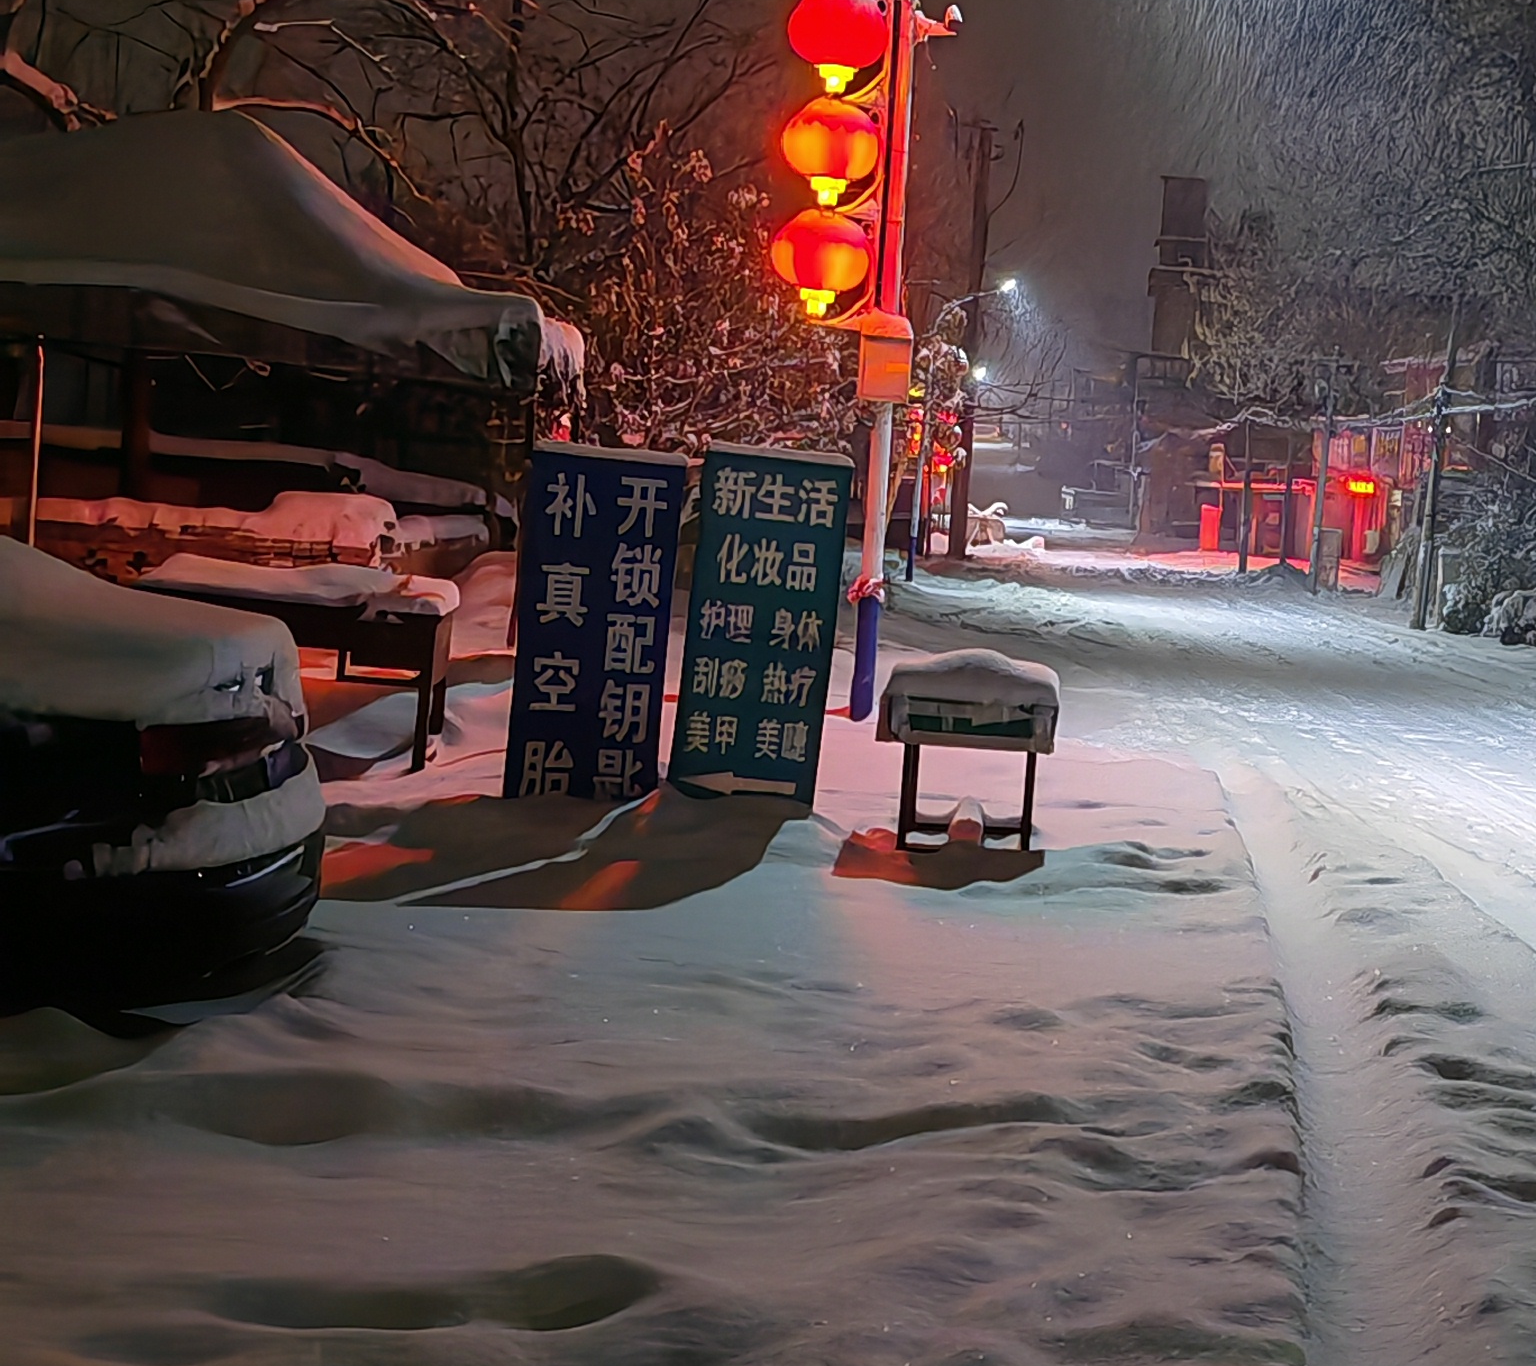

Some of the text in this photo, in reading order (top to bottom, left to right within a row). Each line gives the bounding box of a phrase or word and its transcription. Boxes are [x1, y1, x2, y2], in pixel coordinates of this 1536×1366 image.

[712, 466, 838, 528] 新生活
[717, 533, 817, 592] 化妆品
[518, 472, 597, 797] 补真空胎
[592, 476, 668, 798] 开锁配钥匙
[699, 599, 824, 653] 护理 身体
[761, 661, 817, 707] 热疗
[683, 710, 738, 755] 美甲
